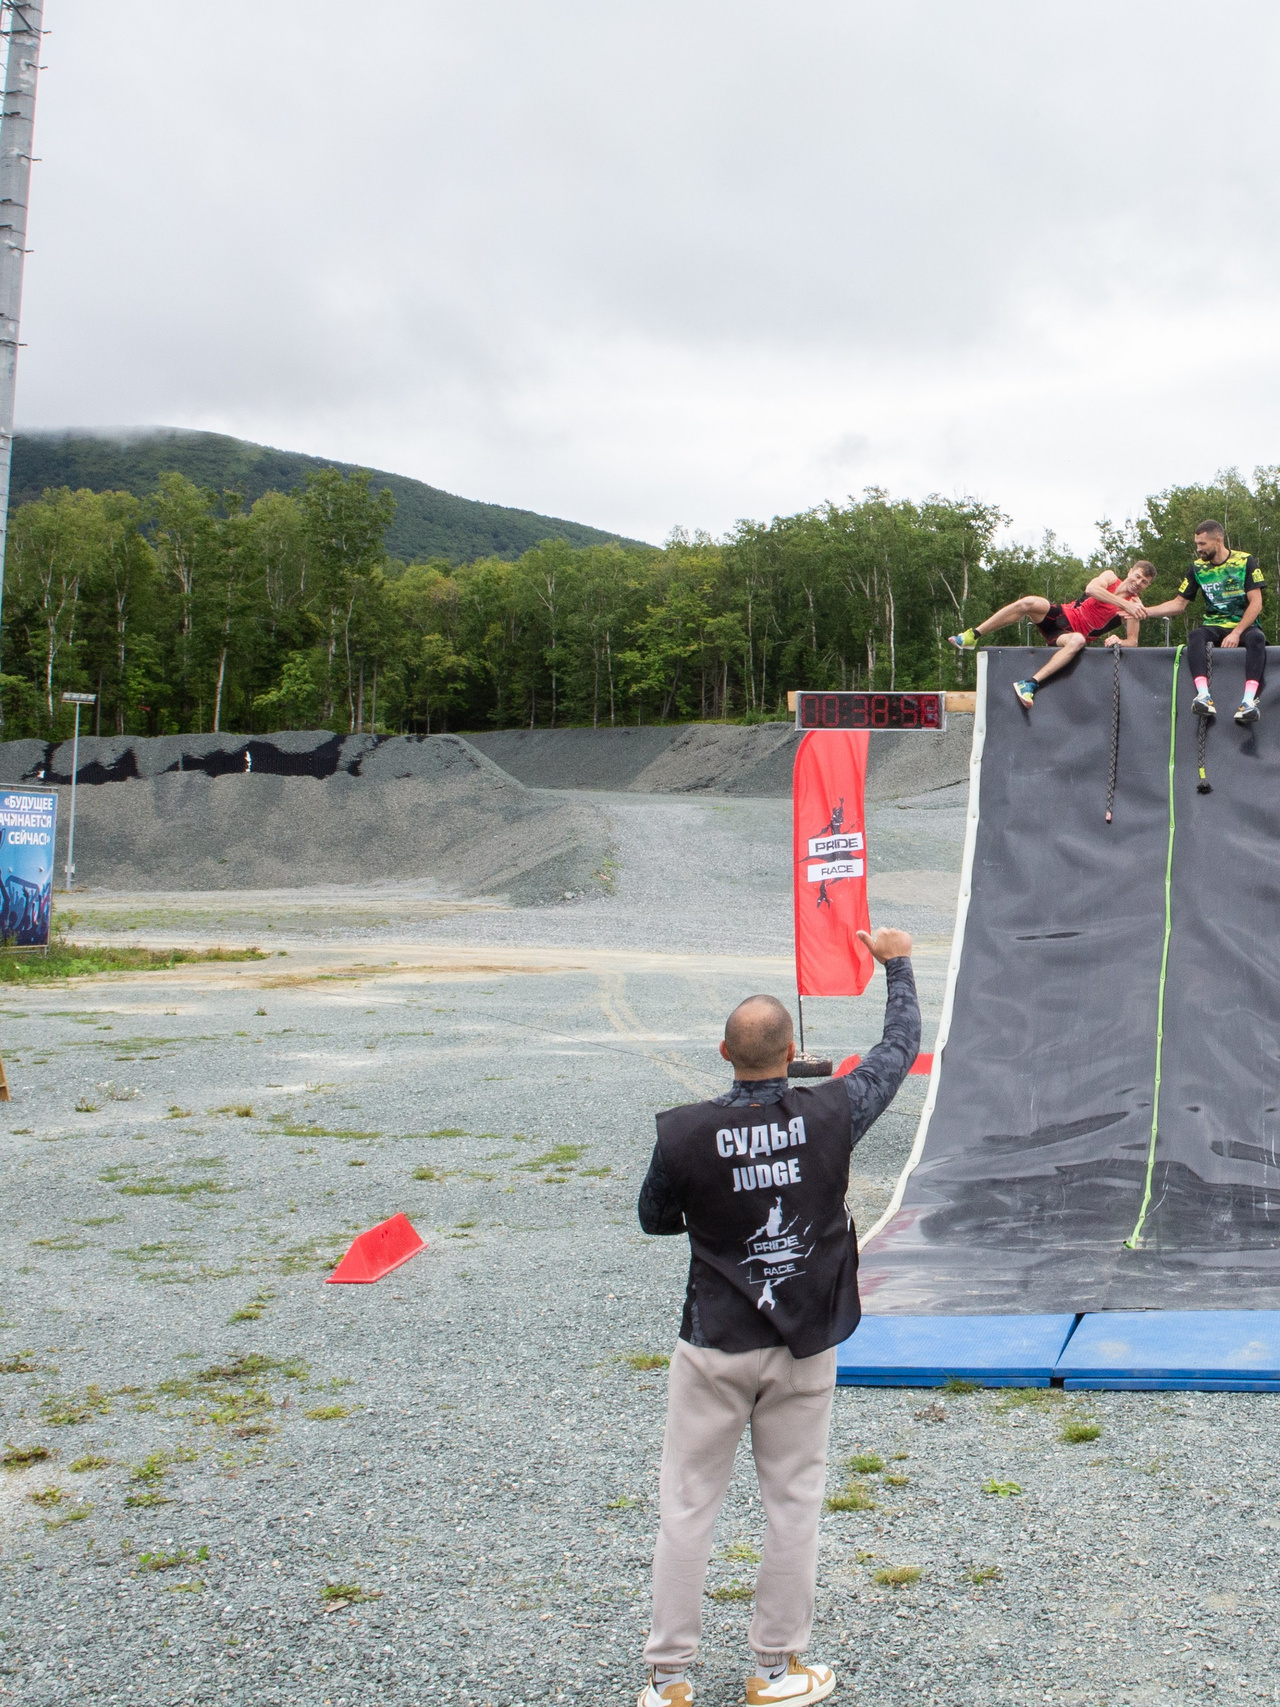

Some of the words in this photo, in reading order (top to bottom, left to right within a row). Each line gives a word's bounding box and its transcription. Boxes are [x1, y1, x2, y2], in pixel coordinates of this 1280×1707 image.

[0, 813, 53, 828] АЧИНАЕТСЯ
[815, 838, 859, 852] PRIDE
[821, 864, 854, 875] RACE
[716, 1116, 806, 1158] СУДЬЯ
[732, 1158, 802, 1192] JUDGE
[753, 1234, 799, 1253] PRIDE
[763, 1263, 796, 1276] RACE
